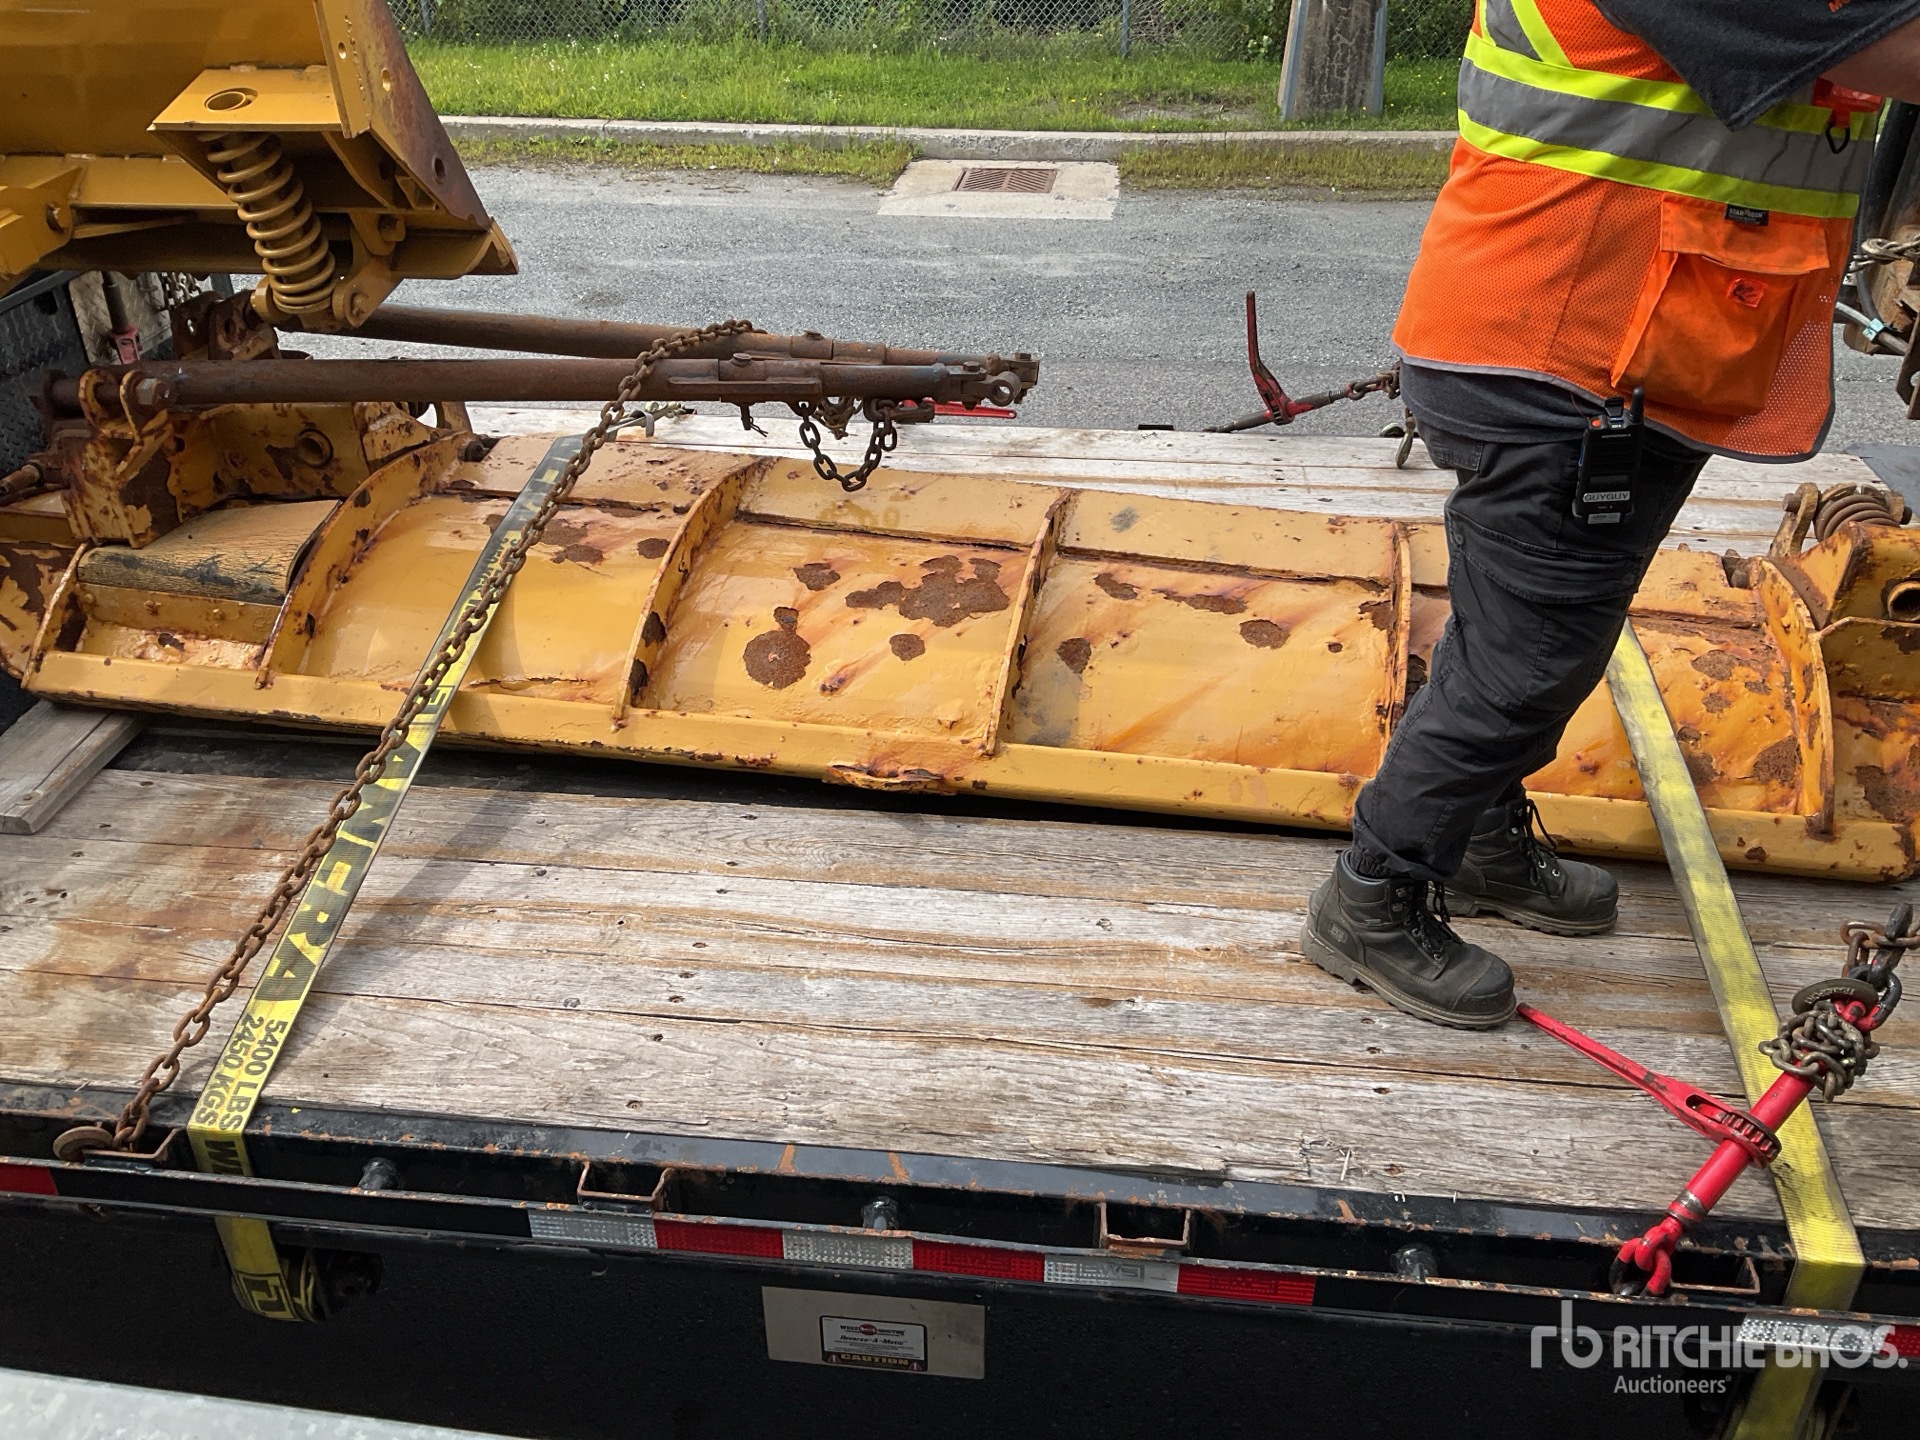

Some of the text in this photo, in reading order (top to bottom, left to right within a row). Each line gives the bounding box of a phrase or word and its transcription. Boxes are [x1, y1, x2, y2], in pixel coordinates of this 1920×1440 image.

[1584, 492, 1629, 501] GUYGUY
[195, 1012, 265, 1127] 2450 KGS
[218, 1019, 289, 1131] 5400 LBS
[840, 1352, 909, 1366] CAUTION
